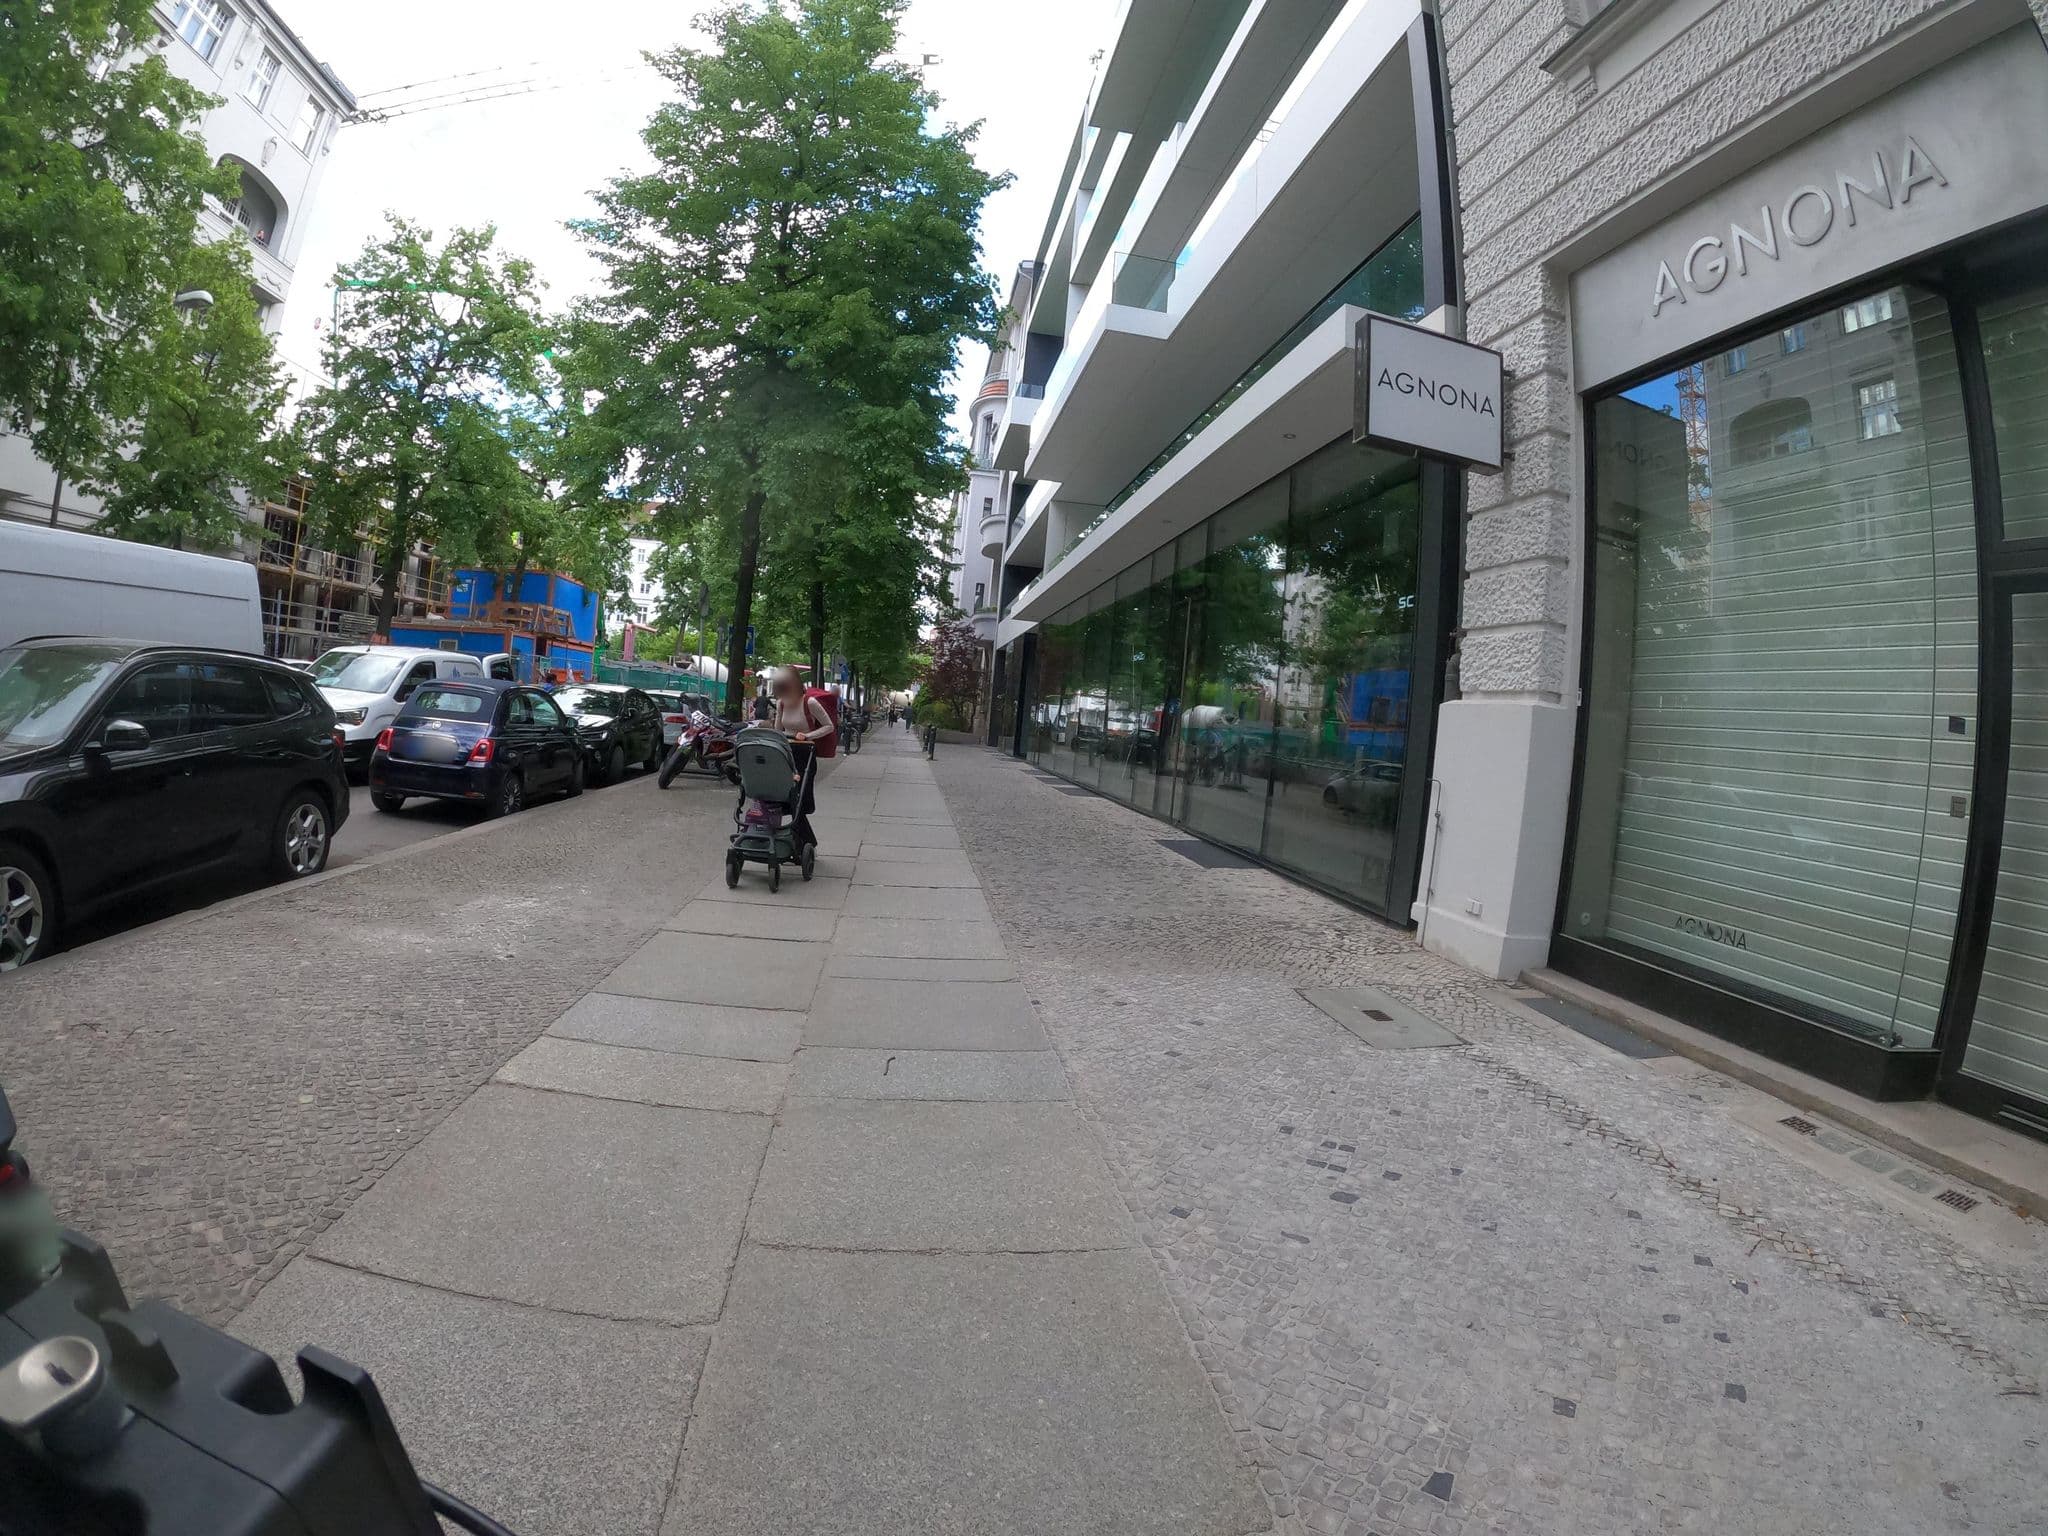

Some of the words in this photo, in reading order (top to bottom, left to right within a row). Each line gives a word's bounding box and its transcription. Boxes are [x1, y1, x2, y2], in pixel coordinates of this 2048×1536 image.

[1653, 135, 1948, 317] AGNONA
[1377, 367, 1495, 418] AGNONA
[1674, 915, 1748, 950] AGNONA
